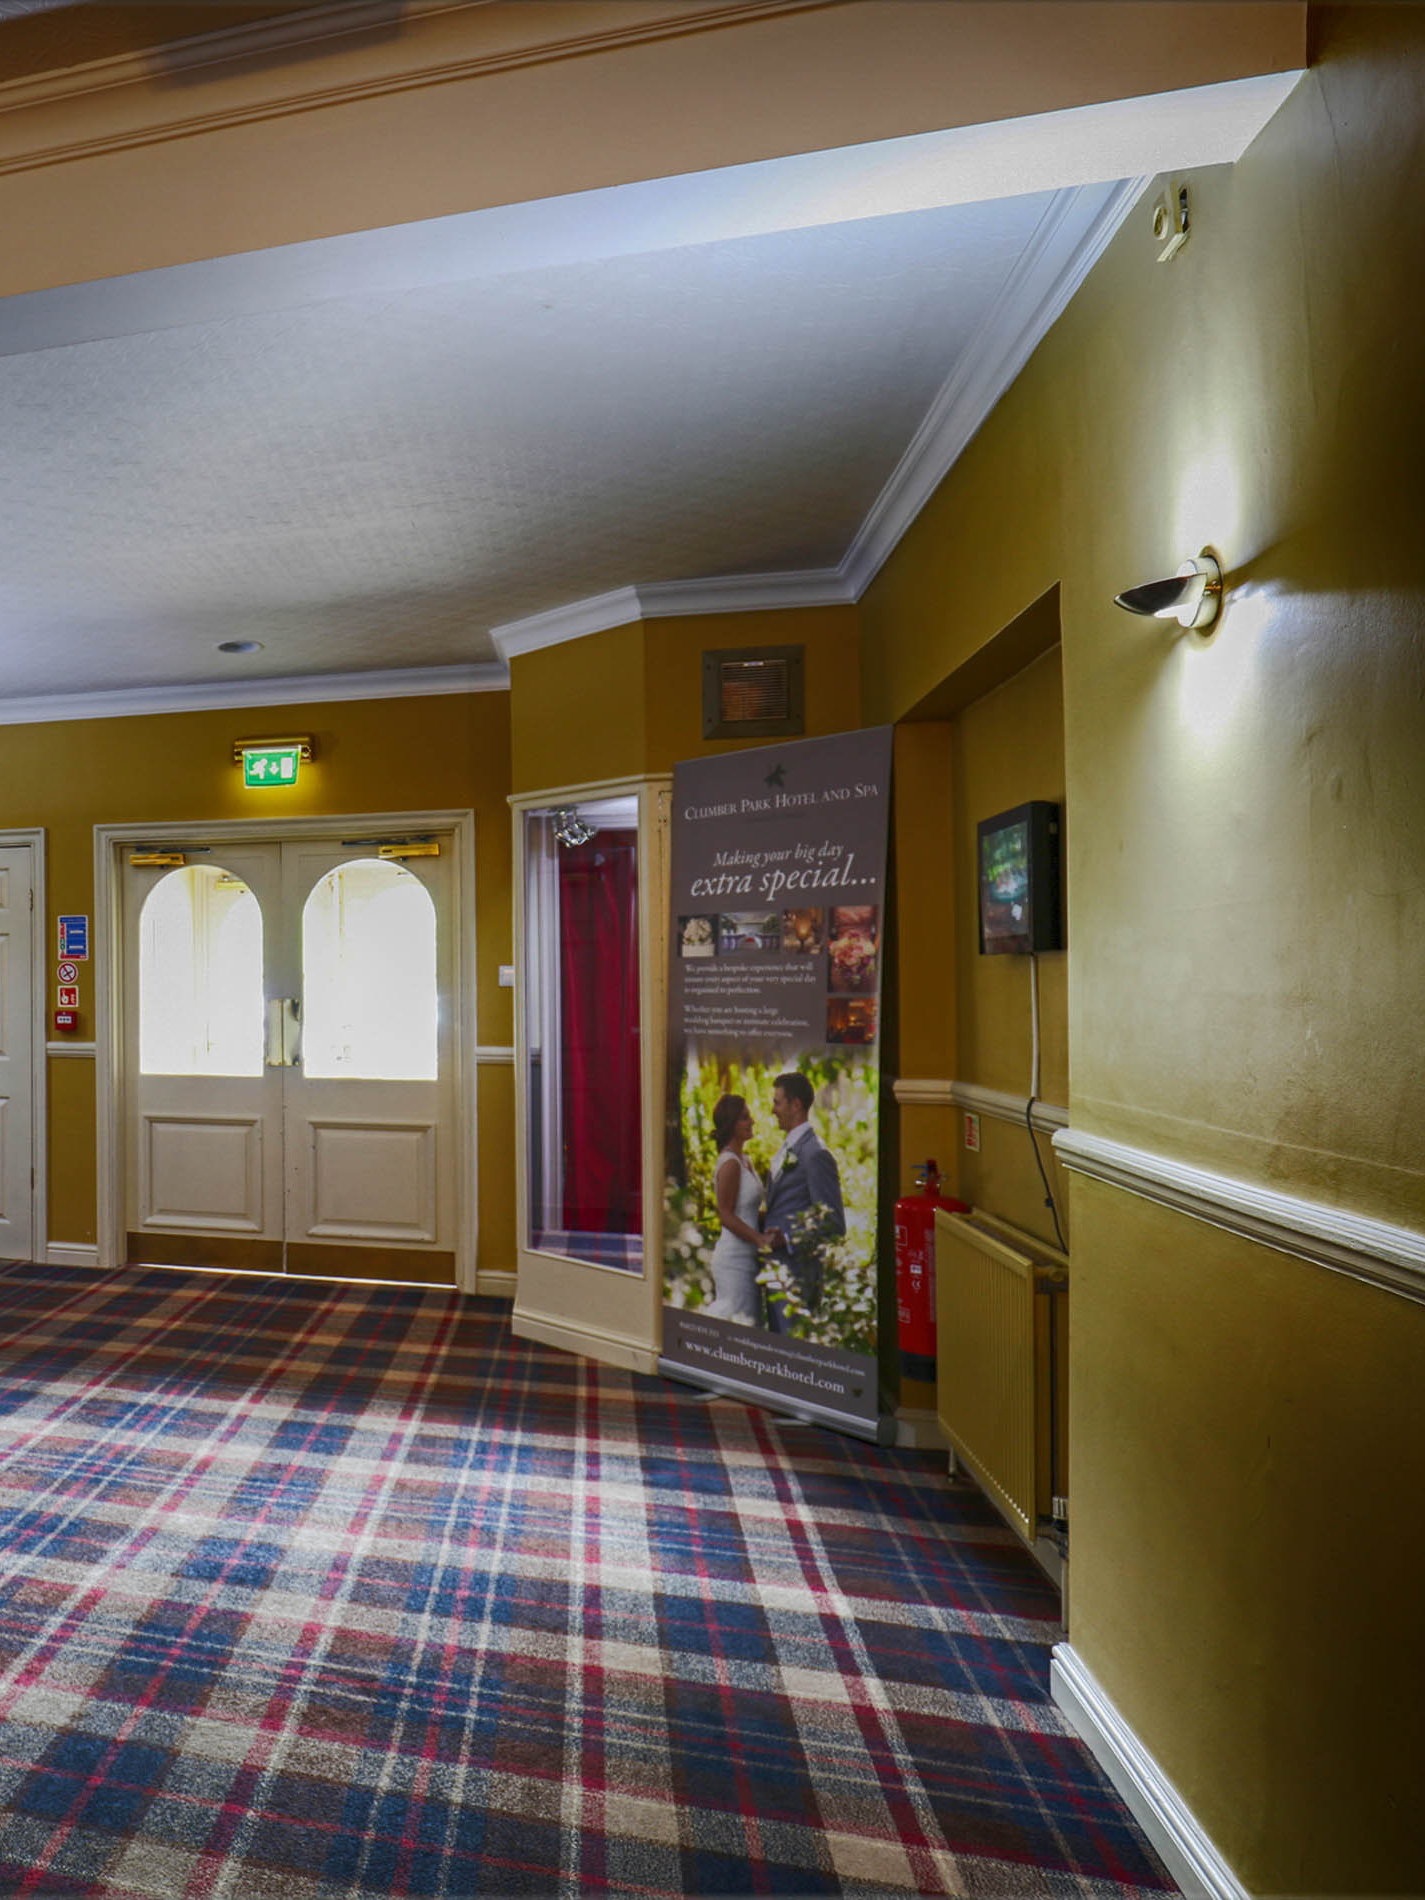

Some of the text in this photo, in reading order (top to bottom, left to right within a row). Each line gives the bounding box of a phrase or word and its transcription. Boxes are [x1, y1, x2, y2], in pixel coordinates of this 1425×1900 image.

[684, 802, 738, 820] CLUMBER
[741, 797, 772, 813] PARK
[775, 793, 818, 809] HOTEL
[821, 788, 851, 802] AND
[854, 783, 880, 799] SPA
[713, 840, 845, 868] Making your big day
[690, 852, 877, 902] extra special...
[685, 1340, 845, 1394] www.clumberparkhotel.com
